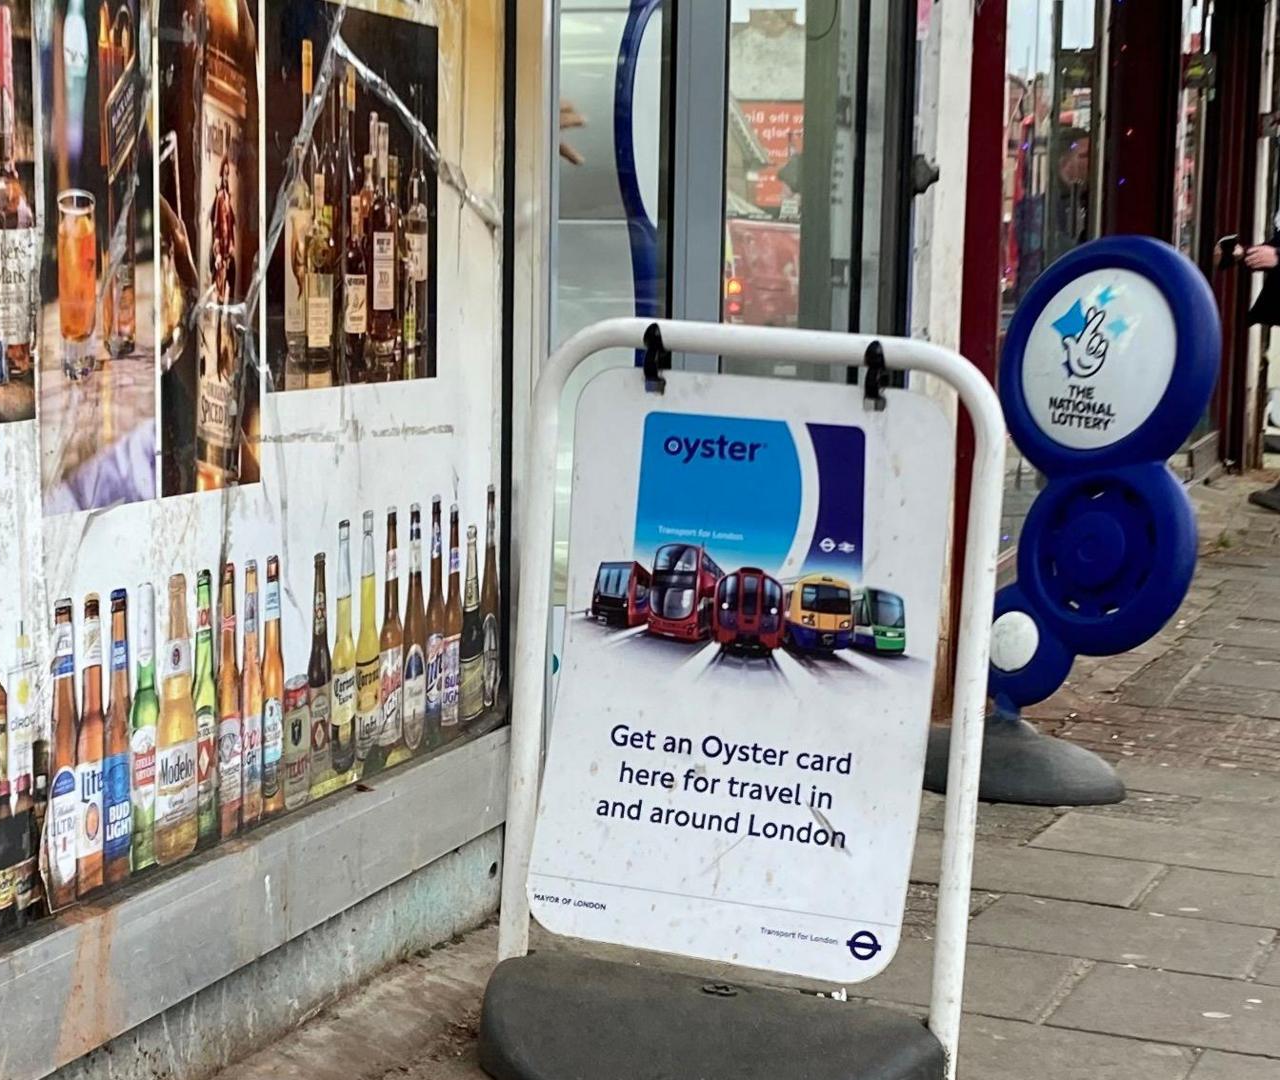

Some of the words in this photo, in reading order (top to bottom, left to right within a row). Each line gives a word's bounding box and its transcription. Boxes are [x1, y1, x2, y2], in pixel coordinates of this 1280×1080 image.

[1068, 385, 1095, 400] THE
[1048, 396, 1116, 417] NATIONAL
[1051, 411, 1111, 431] LOTTERY
[663, 435, 763, 464] oyster
[658, 525, 696, 536] Transport
[698, 528, 711, 538] for
[712, 530, 744, 541] London
[610, 724, 656, 751] Get
[662, 736, 692, 755] an
[701, 735, 789, 766] Oyster
[796, 752, 852, 775] card
[619, 761, 675, 789] here
[683, 769, 720, 794] for
[727, 776, 802, 806] travel
[809, 784, 833, 810] in
[109, 800, 130, 823] BUD
[596, 799, 643, 821] and
[649, 807, 740, 834] around
[747, 814, 846, 849] London
[534, 893, 560, 903] MAYOR
[561, 897, 572, 905] OF
[573, 900, 607, 911] LONDON
[760, 927, 796, 939] Transport
[797, 932, 808, 940] for
[810, 935, 838, 945] London
